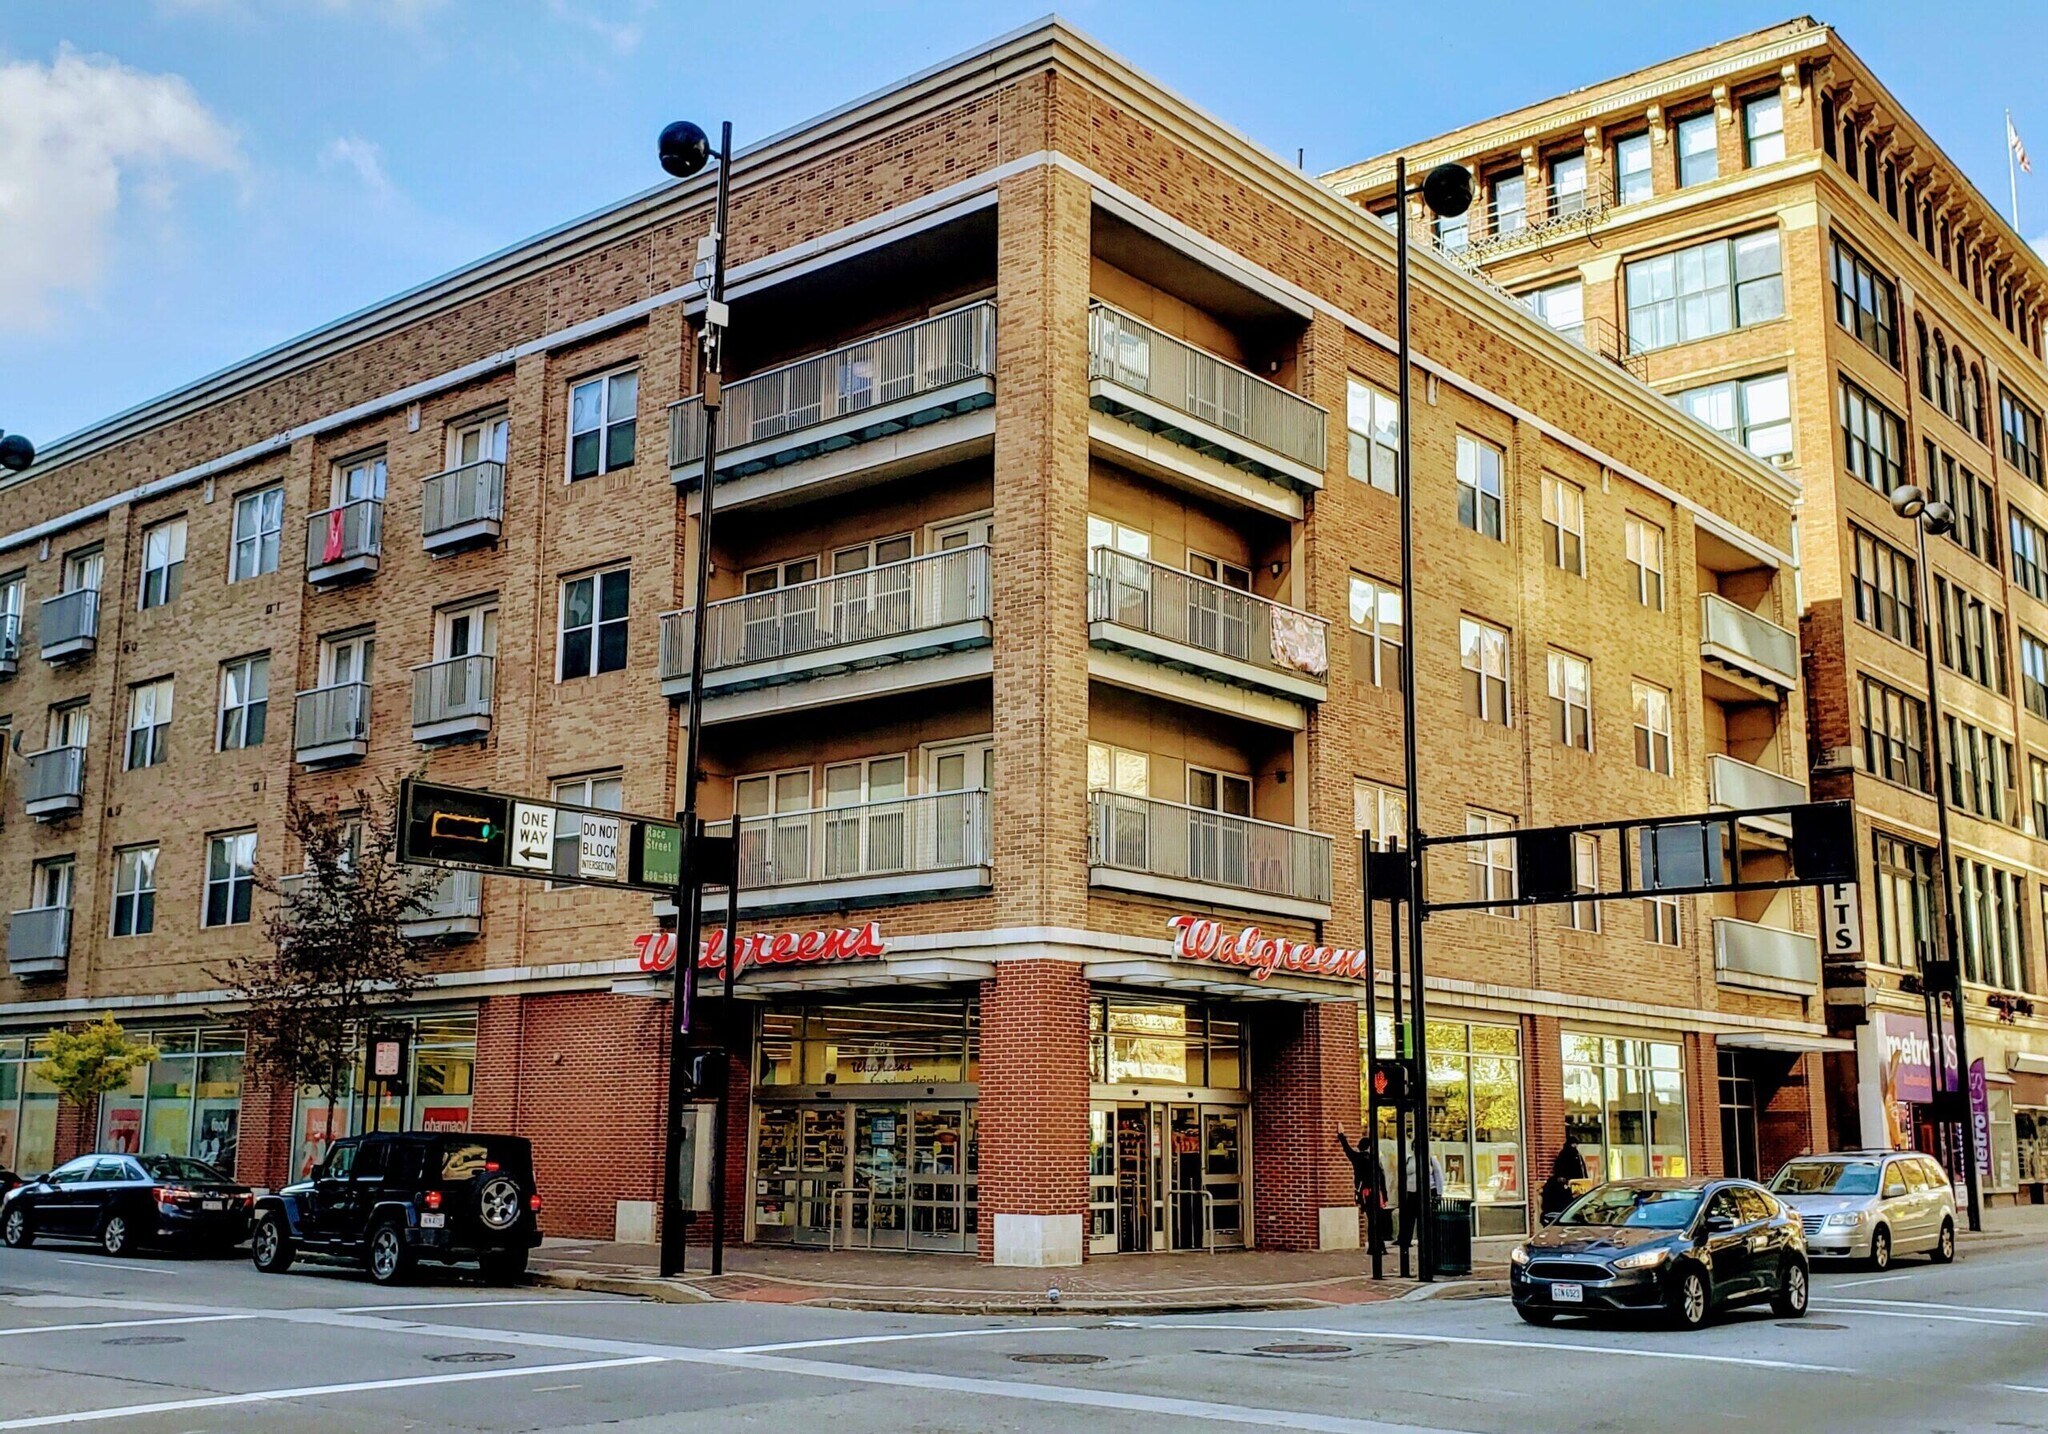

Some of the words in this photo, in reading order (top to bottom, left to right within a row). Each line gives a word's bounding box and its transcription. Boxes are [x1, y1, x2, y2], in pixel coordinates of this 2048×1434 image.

[521, 811, 548, 828] ONE
[520, 828, 548, 845] WAY
[583, 822, 597, 837] DO
[599, 825, 618, 839] NOT
[646, 825, 667, 839] Race
[582, 842, 616, 859] BLOCK
[645, 837, 672, 852] Street
[581, 859, 615, 872] INTERSECTION
[1167, 914, 1380, 982] Walgreen
[424, 1117, 467, 1132] pharmacy
